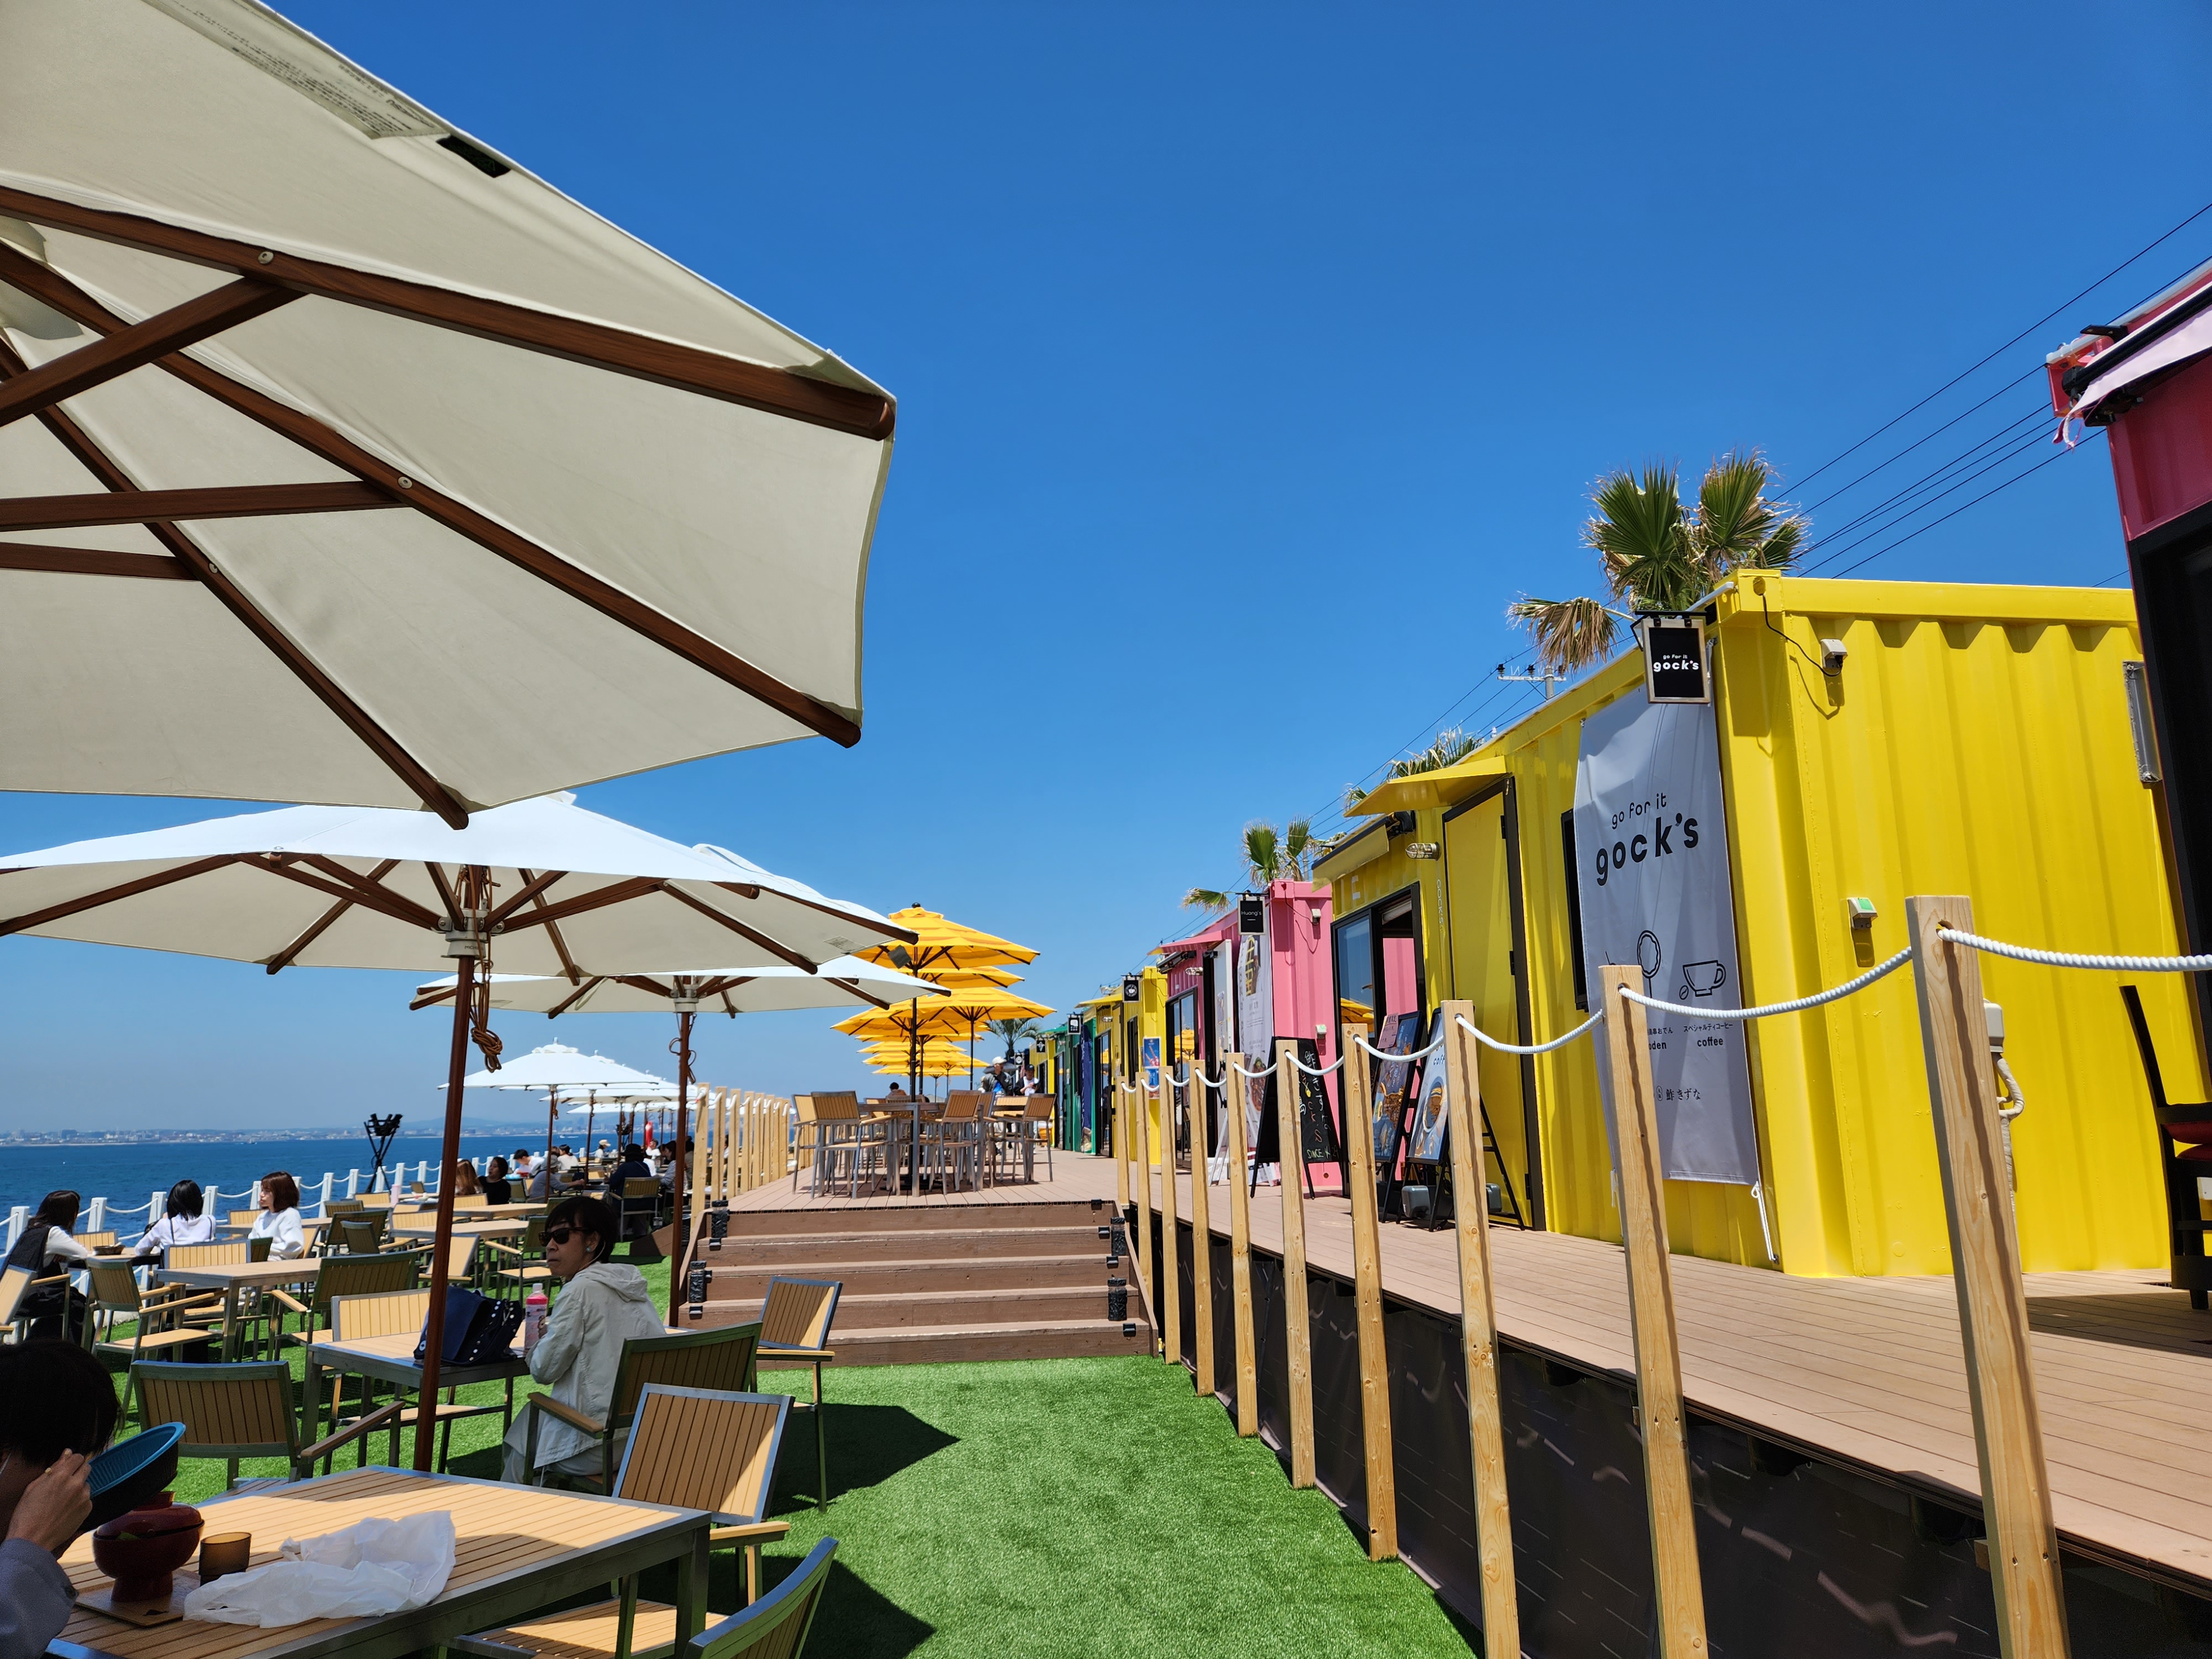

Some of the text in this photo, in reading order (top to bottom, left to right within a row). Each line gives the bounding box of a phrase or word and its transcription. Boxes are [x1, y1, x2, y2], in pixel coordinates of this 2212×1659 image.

[1653, 660, 1699, 672] gock's
[1612, 792, 1667, 830] go for it
[1596, 812, 1699, 886] gock's
[1648, 1040, 1667, 1050] oden
[1697, 1036, 1724, 1047] coffee
[1307, 1149, 1324, 1159] SINCE
